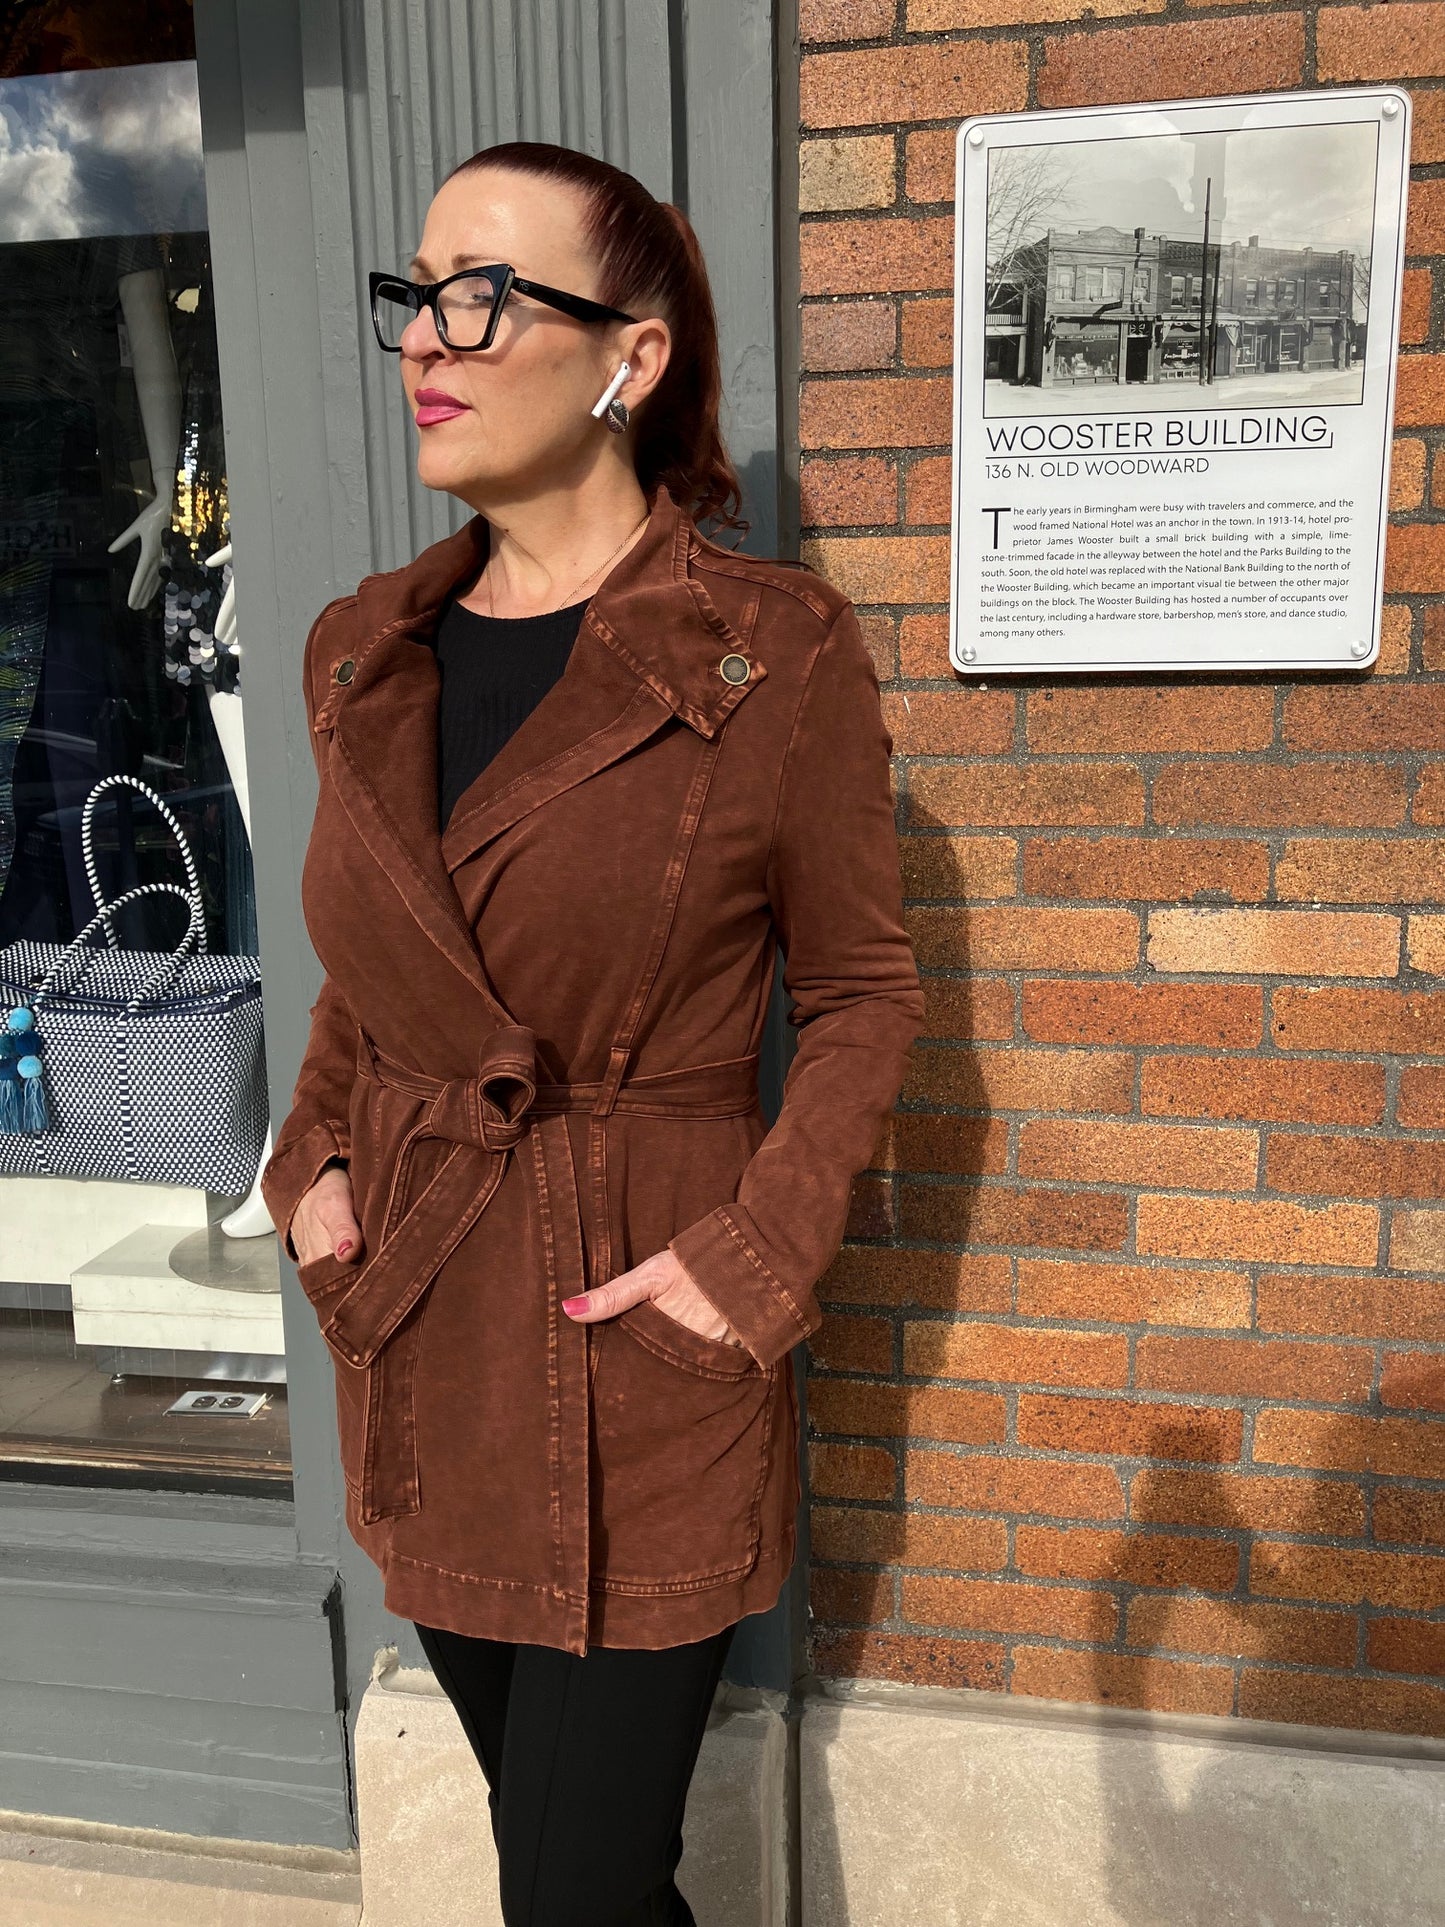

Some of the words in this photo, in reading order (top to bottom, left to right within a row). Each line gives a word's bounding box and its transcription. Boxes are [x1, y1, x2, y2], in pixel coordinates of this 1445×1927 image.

[986, 421, 1153, 451] WOOSTER
[1166, 415, 1328, 447] BUILDING
[985, 464, 1012, 480] 136
[1018, 463, 1035, 479] N.
[1040, 461, 1080, 478] OLD
[1084, 457, 1210, 476] WOODWARD
[1026, 506, 1048, 517] early
[1049, 507, 1072, 517] years
[1074, 506, 1082, 514] in
[1084, 504, 1138, 516] Birmingham
[1140, 505, 1161, 513] were
[1163, 503, 1184, 514] busy
[1186, 502, 1206, 511] with
[1208, 501, 1246, 511] travelers
[1248, 501, 1265, 510] and
[1267, 501, 1317, 510] commerce,
[1318, 498, 1337, 508] and
[1339, 498, 1354, 508] the
[1013, 522, 1038, 531] wood
[1039, 521, 1070, 531] framed
[1072, 520, 1109, 530] National
[1110, 520, 1134, 529] Hotel
[1136, 520, 1154, 528] was
[1155, 520, 1166, 528] an
[1168, 518, 1200, 528] anchor
[1201, 518, 1210, 527] in
[1212, 517, 1227, 526] the
[1229, 518, 1254, 526] town.
[1256, 517, 1266, 525] In
[1268, 516, 1306, 526] 1913-14,
[1308, 515, 1332, 524] hotel
[1012, 538, 1042, 548] prietor
[1046, 537, 1074, 546] James
[1078, 536, 1114, 545] Wooster
[1119, 535, 1139, 544] built
[1156, 534, 1179, 543] small
[1184, 533, 1206, 543] brick
[1212, 532, 1249, 544] building
[1254, 532, 1274, 541] with
[1280, 533, 1286, 541] a
[1291, 530, 1323, 542] simple,
[981, 552, 1045, 562] stone-trimmed
[1046, 552, 1075, 561] facade
[1076, 552, 1085, 560] in
[1087, 551, 1102, 560] the
[1103, 551, 1141, 561] alleyway
[1142, 550, 1181, 559] between
[1183, 549, 1198, 558] the
[1199, 548, 1222, 558] hotel
[1224, 548, 1242, 557] and
[1243, 548, 1258, 557] the
[1260, 547, 1284, 557] Parks
[1285, 546, 1323, 558] Building
[1324, 547, 1334, 556] to
[1336, 546, 1352, 555] the
[1009, 568, 1033, 577] Soon,
[1034, 568, 1049, 577] the
[1050, 567, 1065, 576] old
[1066, 566, 1089, 576] hotel
[1108, 565, 1146, 577] replaced
[1147, 565, 1167, 574] with
[1168, 565, 1184, 574] the
[1185, 564, 1222, 574] National
[1223, 563, 1246, 573] Bank
[1247, 563, 1284, 574] Building
[1286, 564, 1296, 572] to
[1297, 562, 1312, 572] the
[1314, 562, 1339, 571] north
[1340, 561, 1351, 571] of
[981, 584, 995, 593] the
[996, 584, 1032, 592] Wooster
[1034, 582, 1071, 593] Building,
[1072, 582, 1099, 591] which
[1101, 581, 1136, 590] became
[1137, 582, 1149, 590] an
[1151, 581, 1195, 591] important
[1197, 579, 1222, 589] visual
[1224, 579, 1236, 588] tie
[1238, 579, 1277, 588] between
[1279, 578, 1295, 587] the
[1296, 578, 1322, 587] other
[1323, 578, 1350, 588] major
[980, 599, 1020, 609] buildings
[1035, 598, 1050, 607] the
[1079, 597, 1096, 606] The
[1097, 597, 1133, 606] Wooster
[1135, 596, 1171, 606] Building
[1173, 595, 1189, 604] has
[1190, 595, 1221, 604] hosted
[1231, 594, 1267, 603] number
[1268, 593, 1279, 603] of
[1280, 594, 1327, 604] occupants
[980, 614, 994, 623] the
[996, 614, 1011, 623] last
[1012, 614, 1046, 624] century,
[1048, 612, 1088, 623] including
[1096, 612, 1137, 621] hardware
[1138, 612, 1162, 621] store,
[1163, 610, 1216, 621] barbershop,
[1244, 611, 1268, 619] store,
[1270, 609, 1287, 618] and
[1288, 609, 1316, 618] dance
[1318, 608, 1348, 618] studio,
[979, 630, 1010, 640] among
[1011, 630, 1036, 639] many
[1036, 628, 1066, 637] others.
